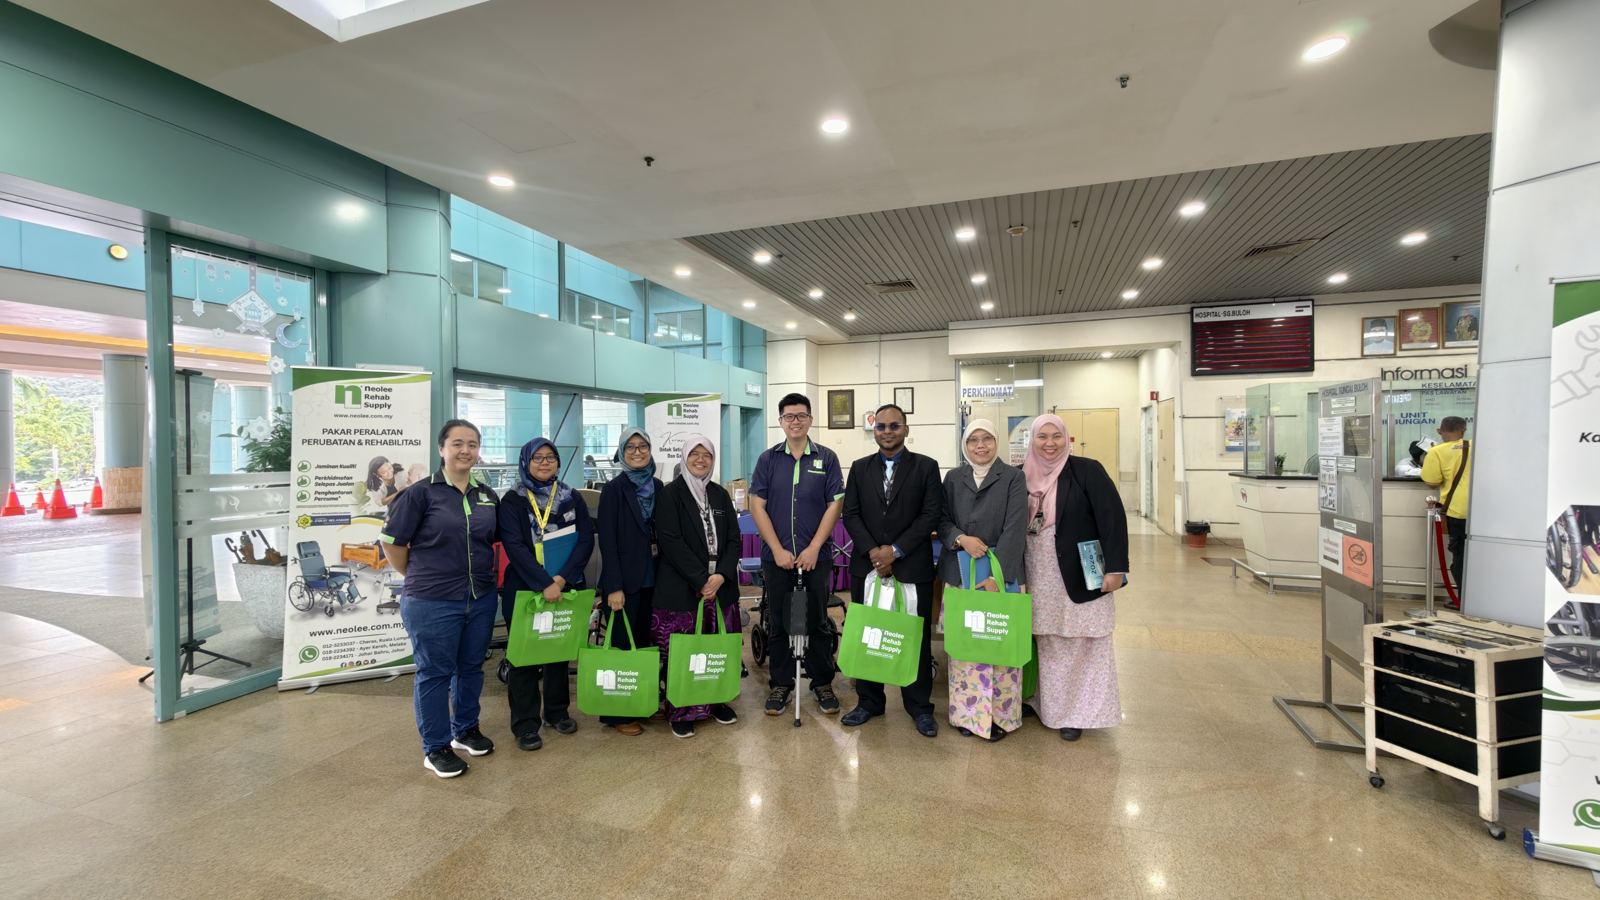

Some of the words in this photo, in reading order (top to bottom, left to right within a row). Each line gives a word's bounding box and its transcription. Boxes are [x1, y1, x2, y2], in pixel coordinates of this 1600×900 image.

[1381, 365, 1468, 381] Informasi
[364, 393, 390, 401] Rehab
[1400, 411, 1428, 419] UNIT
